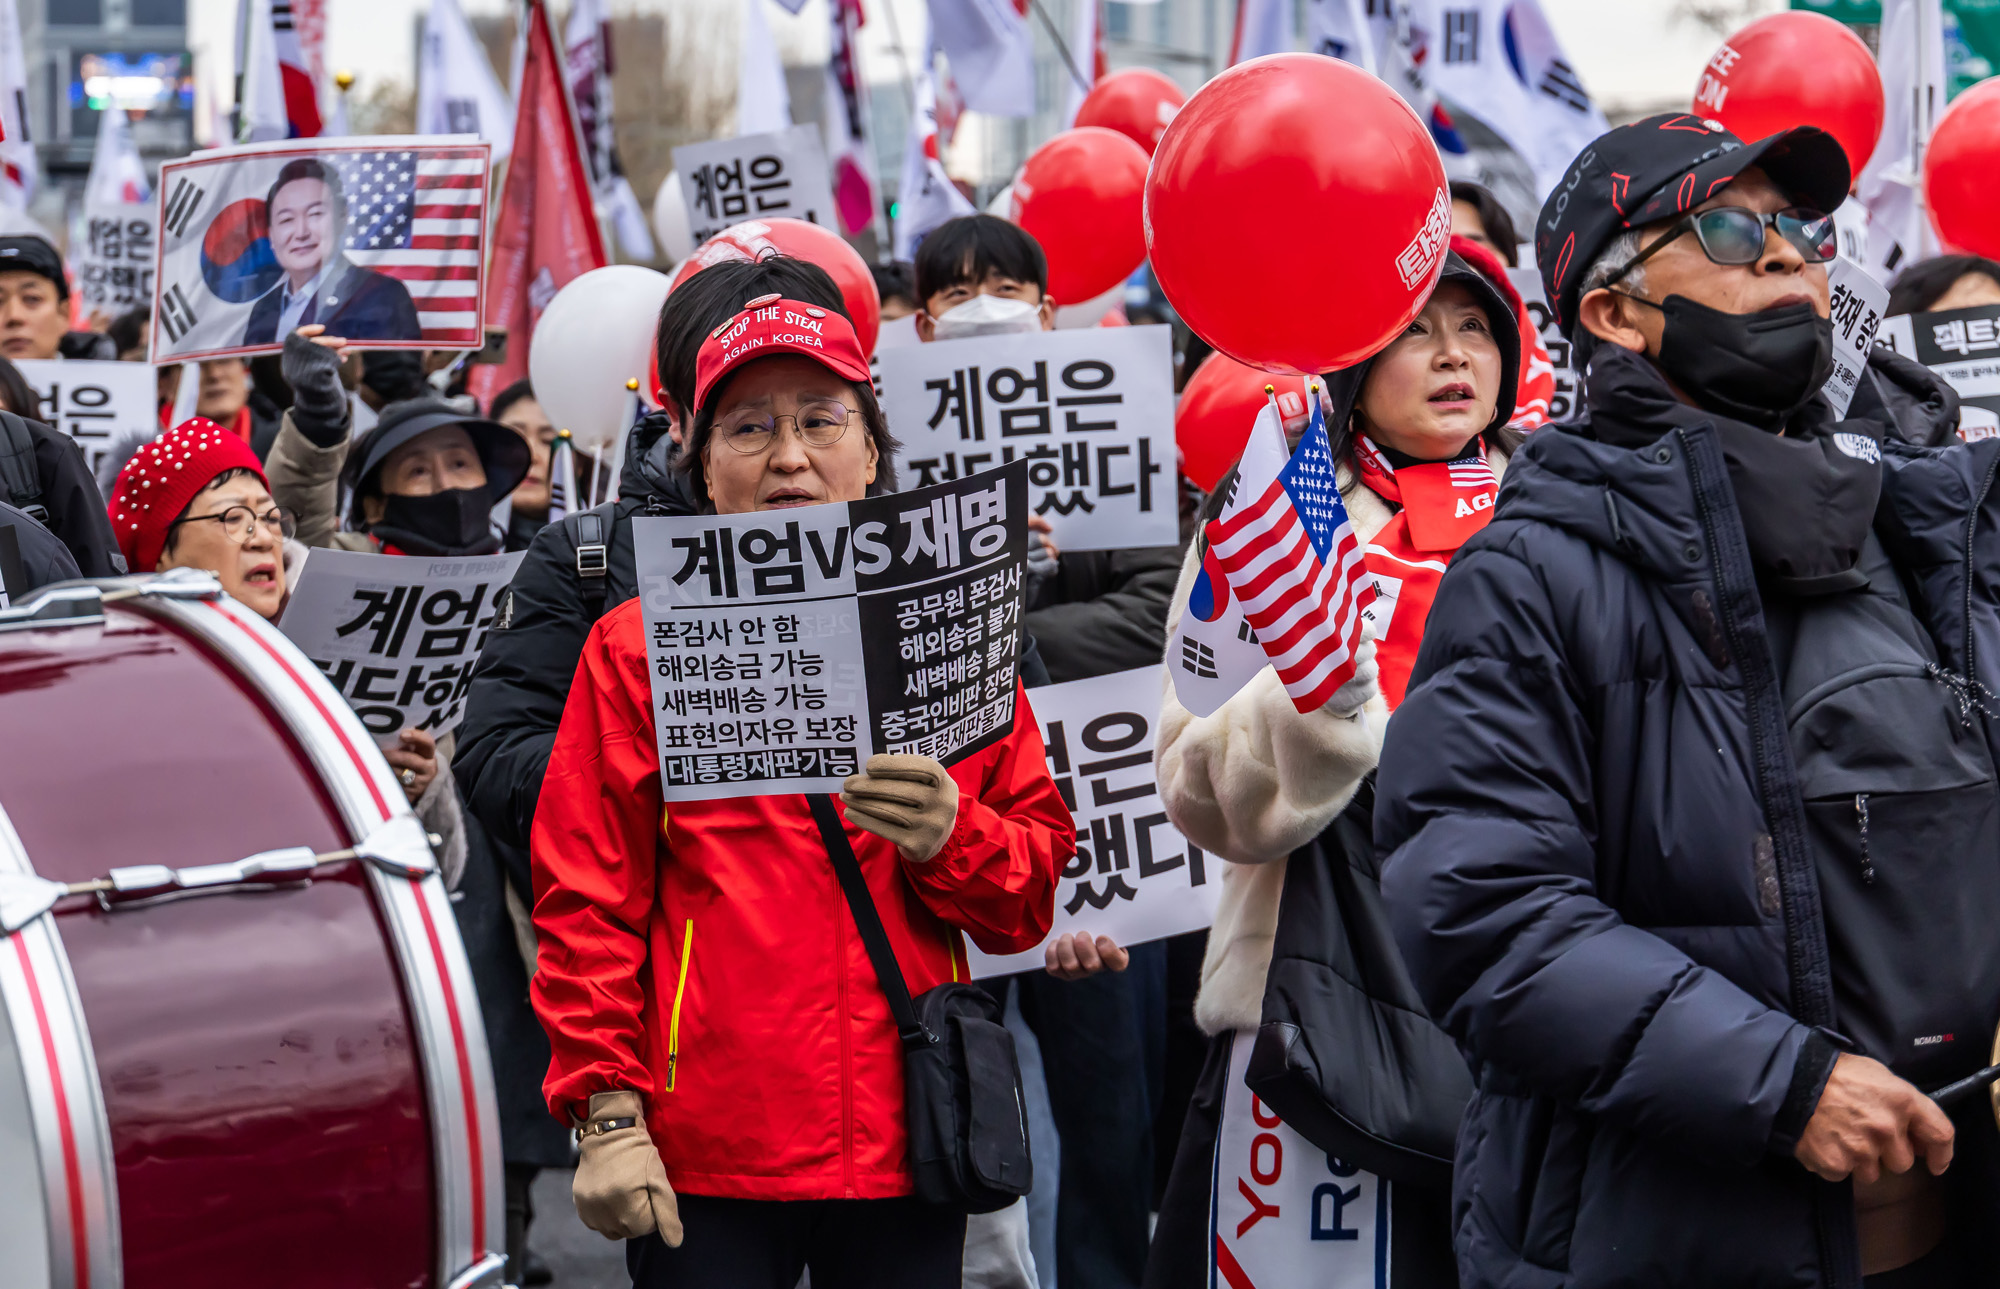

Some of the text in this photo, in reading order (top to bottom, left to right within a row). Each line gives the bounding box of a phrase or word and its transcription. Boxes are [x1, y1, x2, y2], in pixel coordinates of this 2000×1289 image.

[720, 306, 823, 350] STOP THE STEAL
[1932, 317, 2000, 356] 팩트
[723, 333, 823, 365] AGAIN KOREA
[925, 360, 1124, 442] 계엄은
[899, 478, 1008, 569] 재명
[896, 563, 1023, 630] 공무원 폰검사
[653, 614, 801, 648] 폰검사 안 함
[899, 596, 1021, 663] 해외송금 불가
[655, 649, 824, 683] 해외송금 가능
[904, 650, 983, 698] 새벽배송
[986, 629, 1018, 670] 불가
[661, 686, 768, 717] 새벽배송
[774, 683, 828, 711] 가능
[880, 680, 982, 740] 중국인비판
[984, 661, 1015, 700] 징역
[665, 714, 858, 749] 표현의자유 보장
[667, 748, 856, 784] 대통령재판가능
